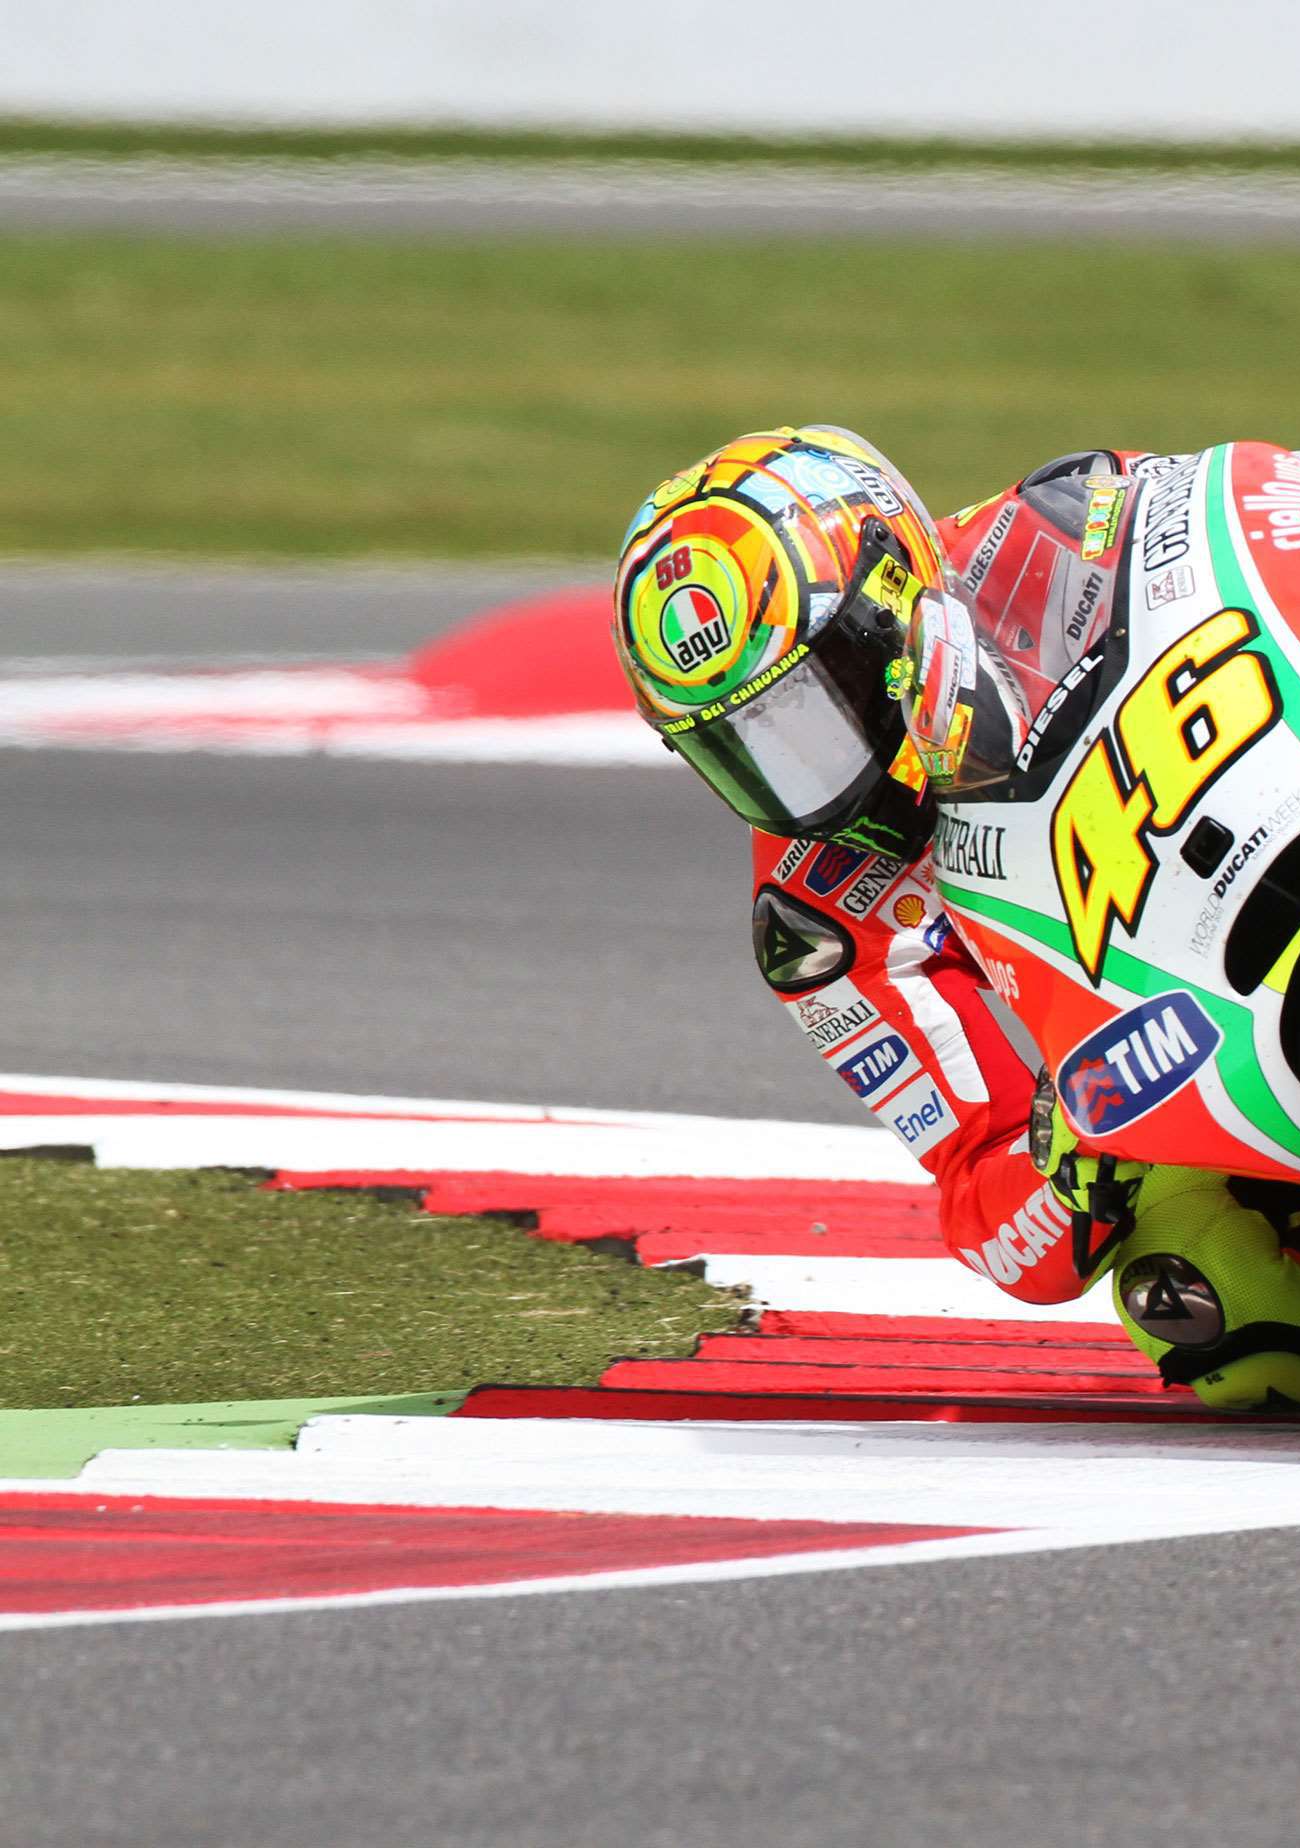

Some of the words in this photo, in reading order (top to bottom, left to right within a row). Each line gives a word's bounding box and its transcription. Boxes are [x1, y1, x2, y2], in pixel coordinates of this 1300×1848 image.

[655, 546, 693, 591] 58
[1066, 571, 1104, 642] DUCATI
[677, 621, 723, 667] agv
[729, 643, 810, 705] CHIHUAHUA
[1016, 654, 1105, 773] DIESEL
[1050, 607, 1284, 989] 46
[852, 1041, 899, 1086] TIM
[1105, 1006, 1199, 1095] TIM
[894, 1089, 944, 1143] Enel
